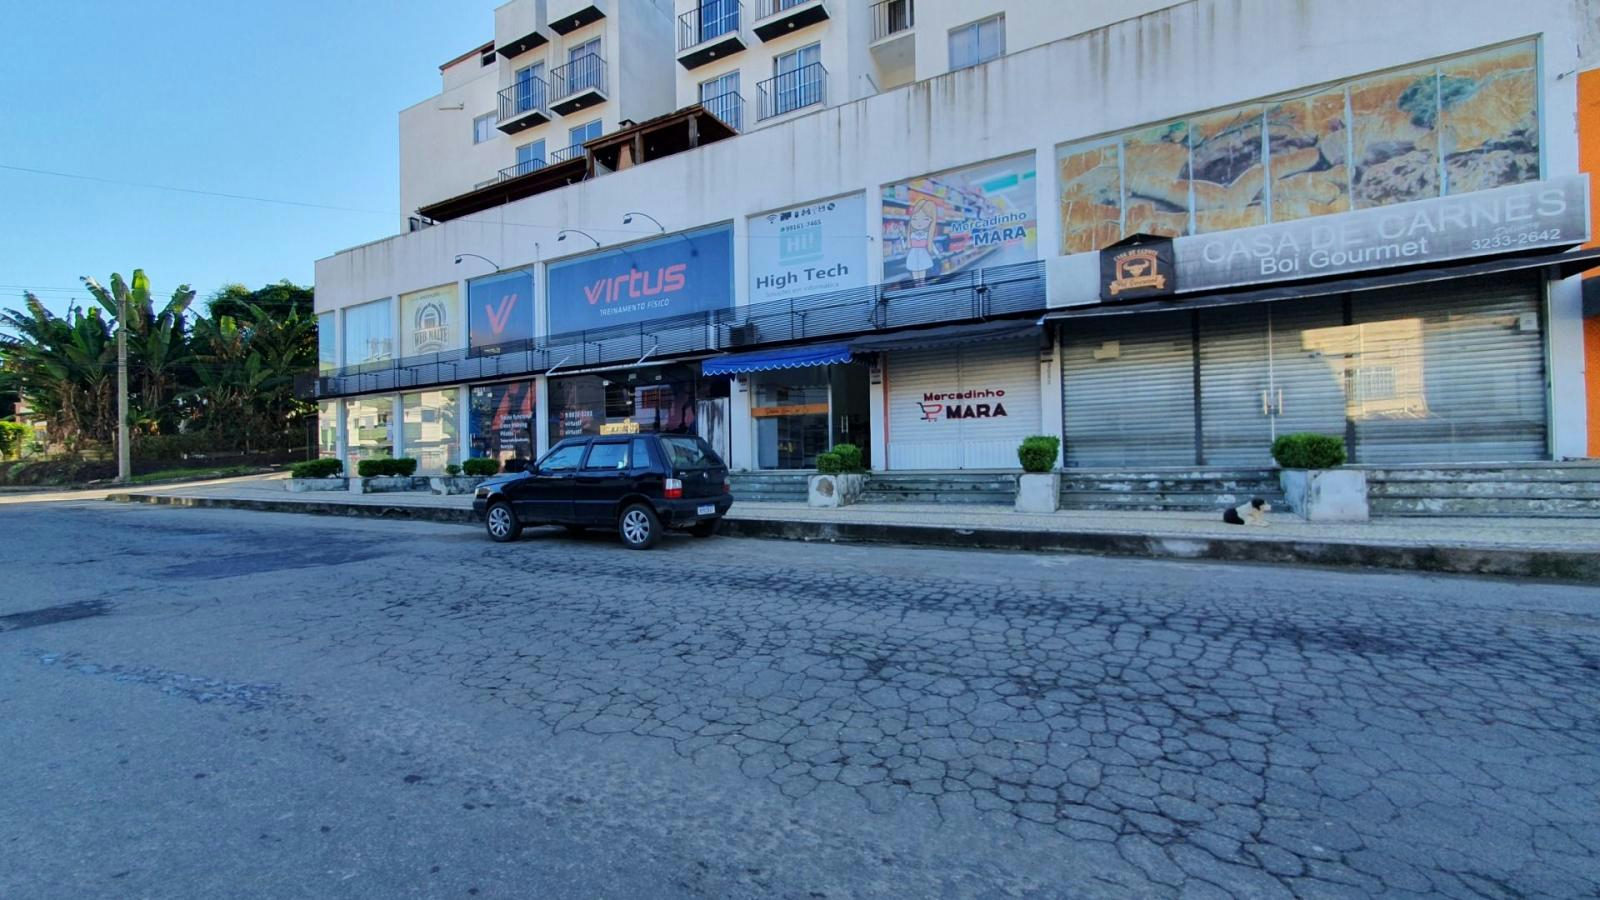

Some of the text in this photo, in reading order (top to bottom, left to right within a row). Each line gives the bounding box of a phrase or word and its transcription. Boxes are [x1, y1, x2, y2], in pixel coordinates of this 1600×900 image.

[952, 211, 1028, 232] Mercadinho
[1203, 185, 1567, 271] CASA DE CARNES
[974, 225, 1027, 246] MARA
[1471, 228, 1561, 250] 3233-2642
[1259, 237, 1429, 276] Boi Gourmet
[756, 263, 849, 289] High Tech
[600, 301, 646, 316] TREINAMENTO
[924, 389, 1005, 401] Mercadinho
[946, 403, 1008, 419] MARA
